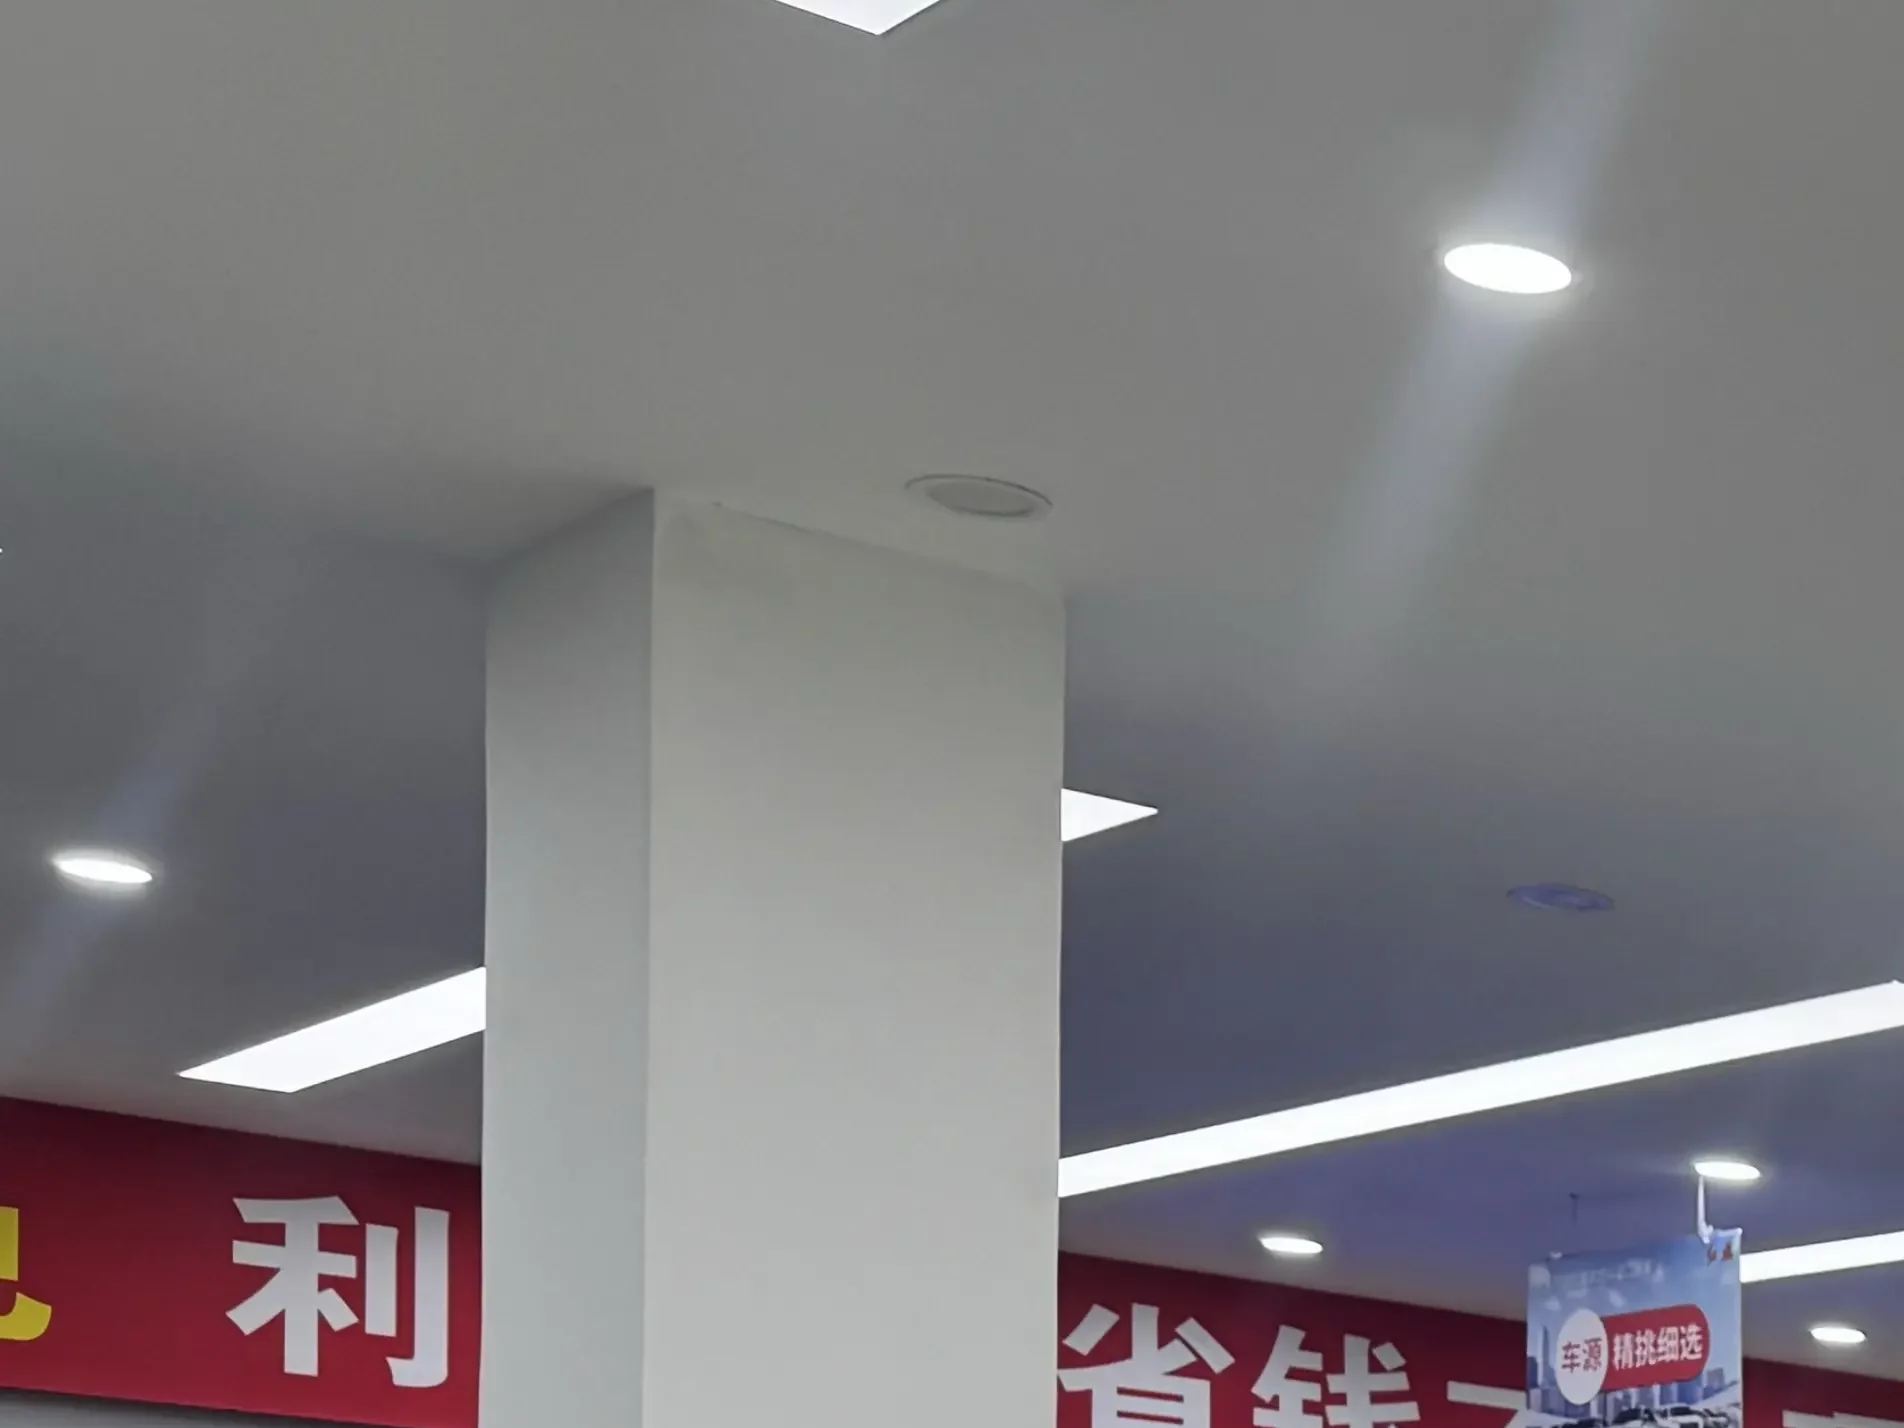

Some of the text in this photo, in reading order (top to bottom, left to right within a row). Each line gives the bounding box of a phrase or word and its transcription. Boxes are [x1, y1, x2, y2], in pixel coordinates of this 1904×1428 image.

[226, 1196, 450, 1388] 利
[1561, 1324, 1703, 1373] 车源 精挑细选
